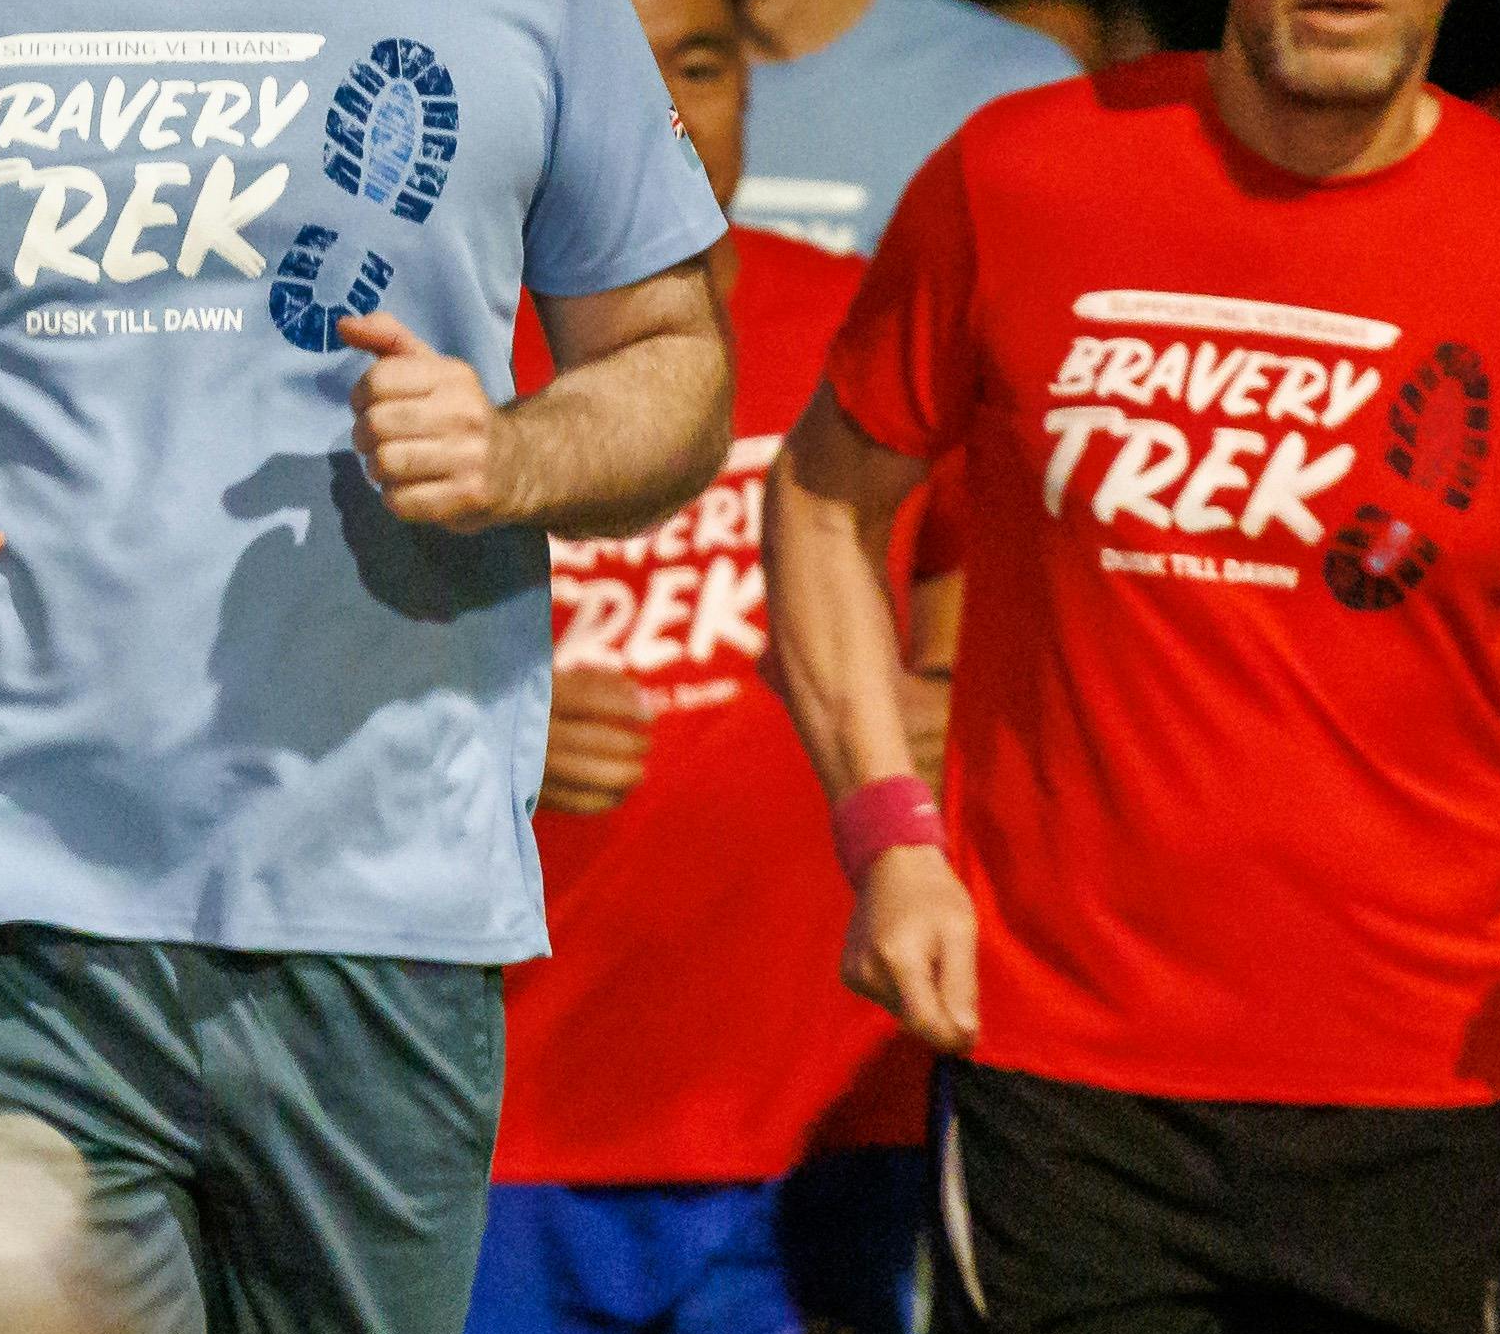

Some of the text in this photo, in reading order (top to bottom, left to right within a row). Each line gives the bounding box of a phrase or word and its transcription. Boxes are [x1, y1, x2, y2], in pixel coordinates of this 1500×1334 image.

[3, 40, 291, 57] SUPPORTING VETERANS
[26, 307, 244, 335] DUSK TILL DAWN
[1050, 337, 1380, 428] BRAVERY
[1045, 406, 1356, 544] TREK
[1170, 553, 1219, 581] TILL
[551, 555, 768, 673] REK
